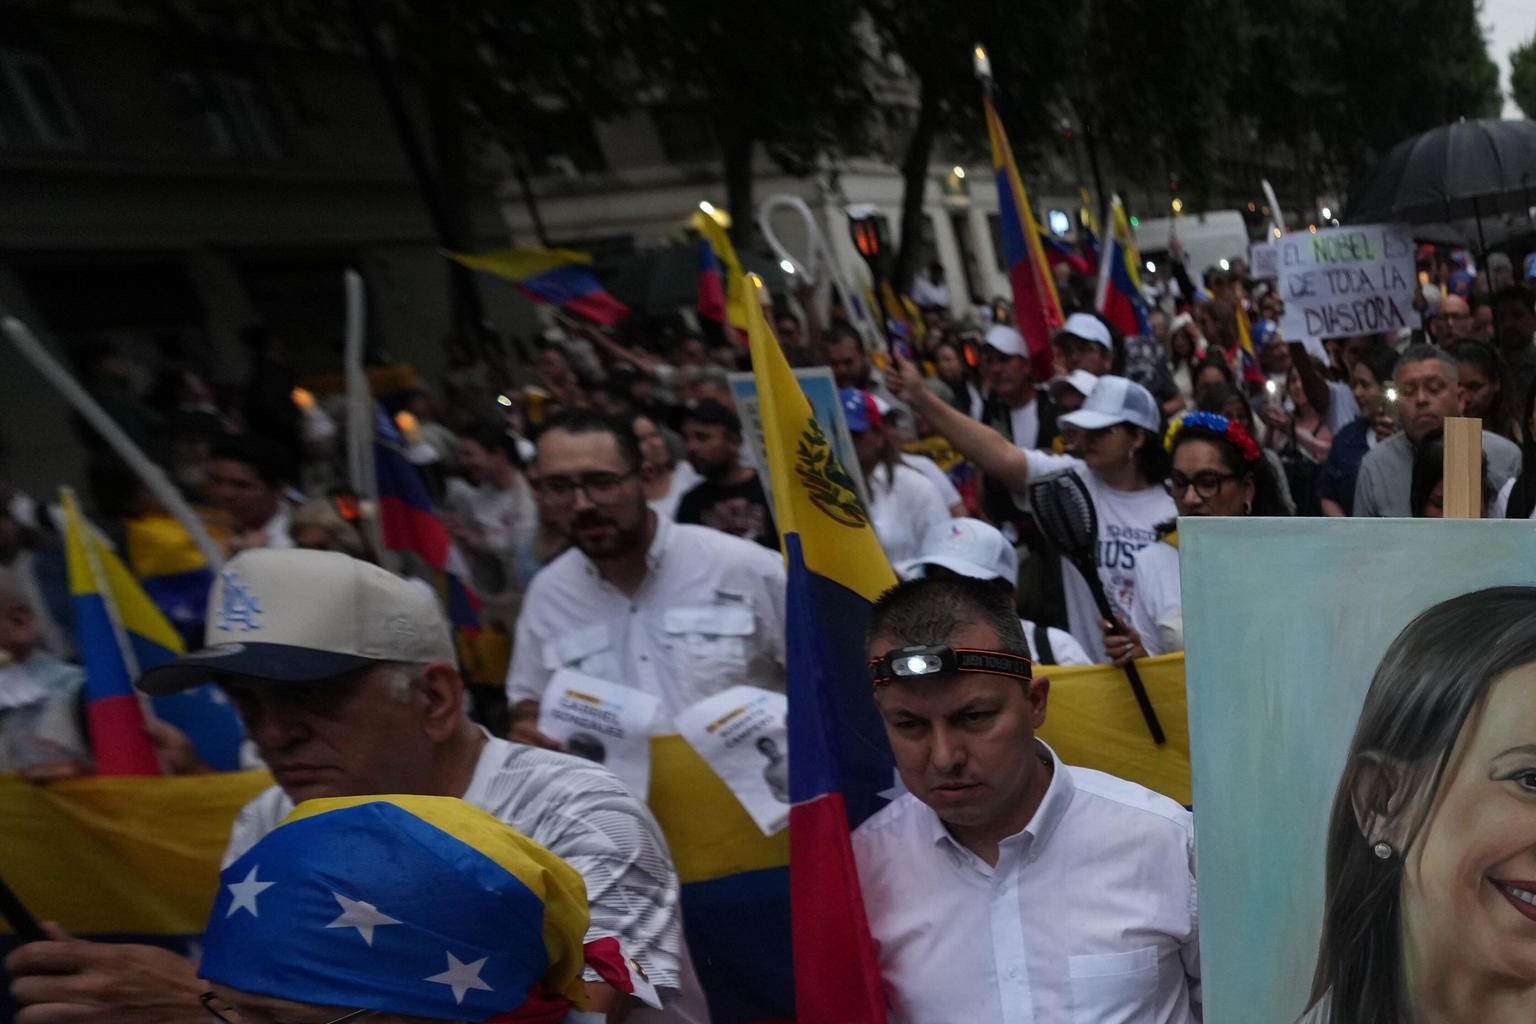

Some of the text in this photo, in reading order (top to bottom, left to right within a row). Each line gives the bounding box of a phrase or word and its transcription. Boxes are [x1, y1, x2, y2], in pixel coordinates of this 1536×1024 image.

[1312, 232, 1375, 263] NOBEL
[1289, 265, 1407, 297] DE TODA LA
